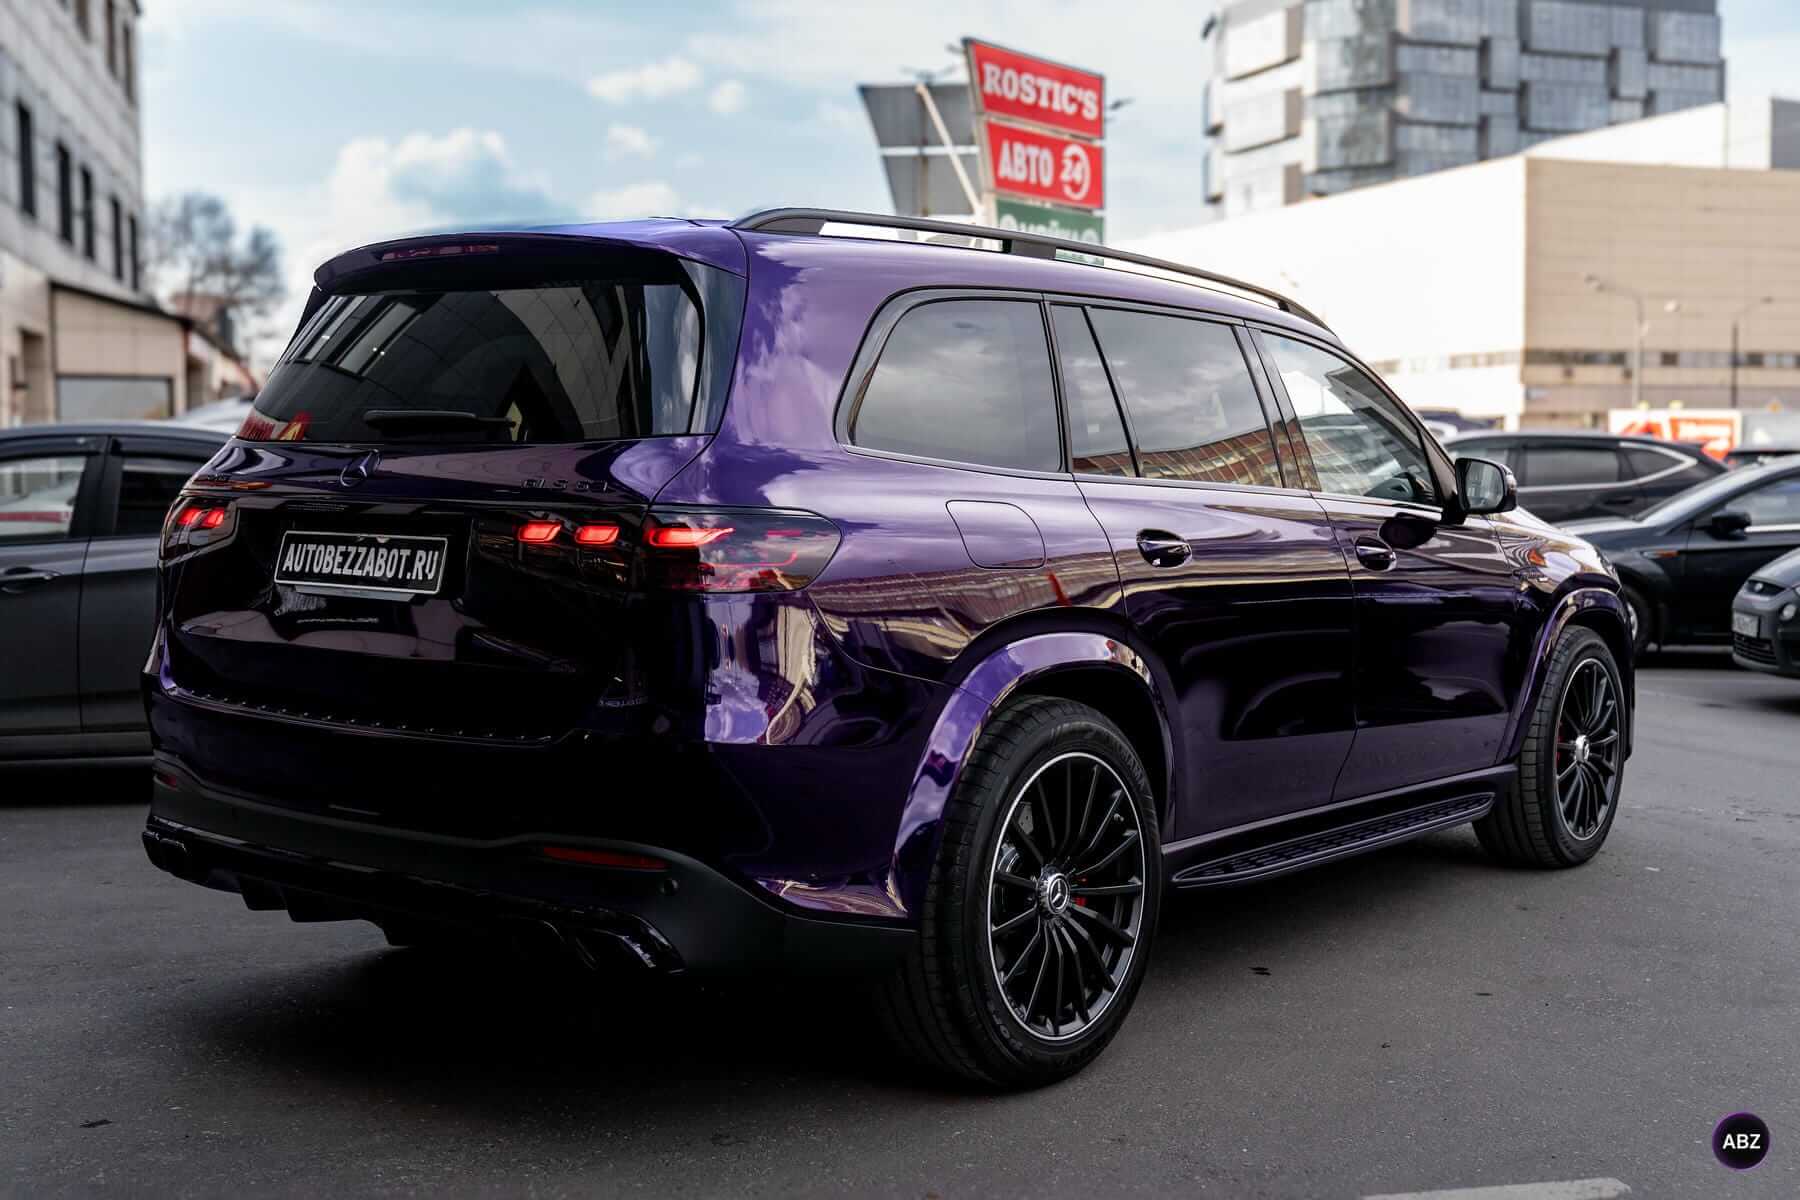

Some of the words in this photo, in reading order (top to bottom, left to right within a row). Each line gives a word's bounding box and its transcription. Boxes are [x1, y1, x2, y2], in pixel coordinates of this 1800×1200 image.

[984, 63, 1098, 119] ROSTIC'S
[999, 141, 1054, 187] АВТО
[282, 543, 439, 580] AUTOBEZZABOT.RU
